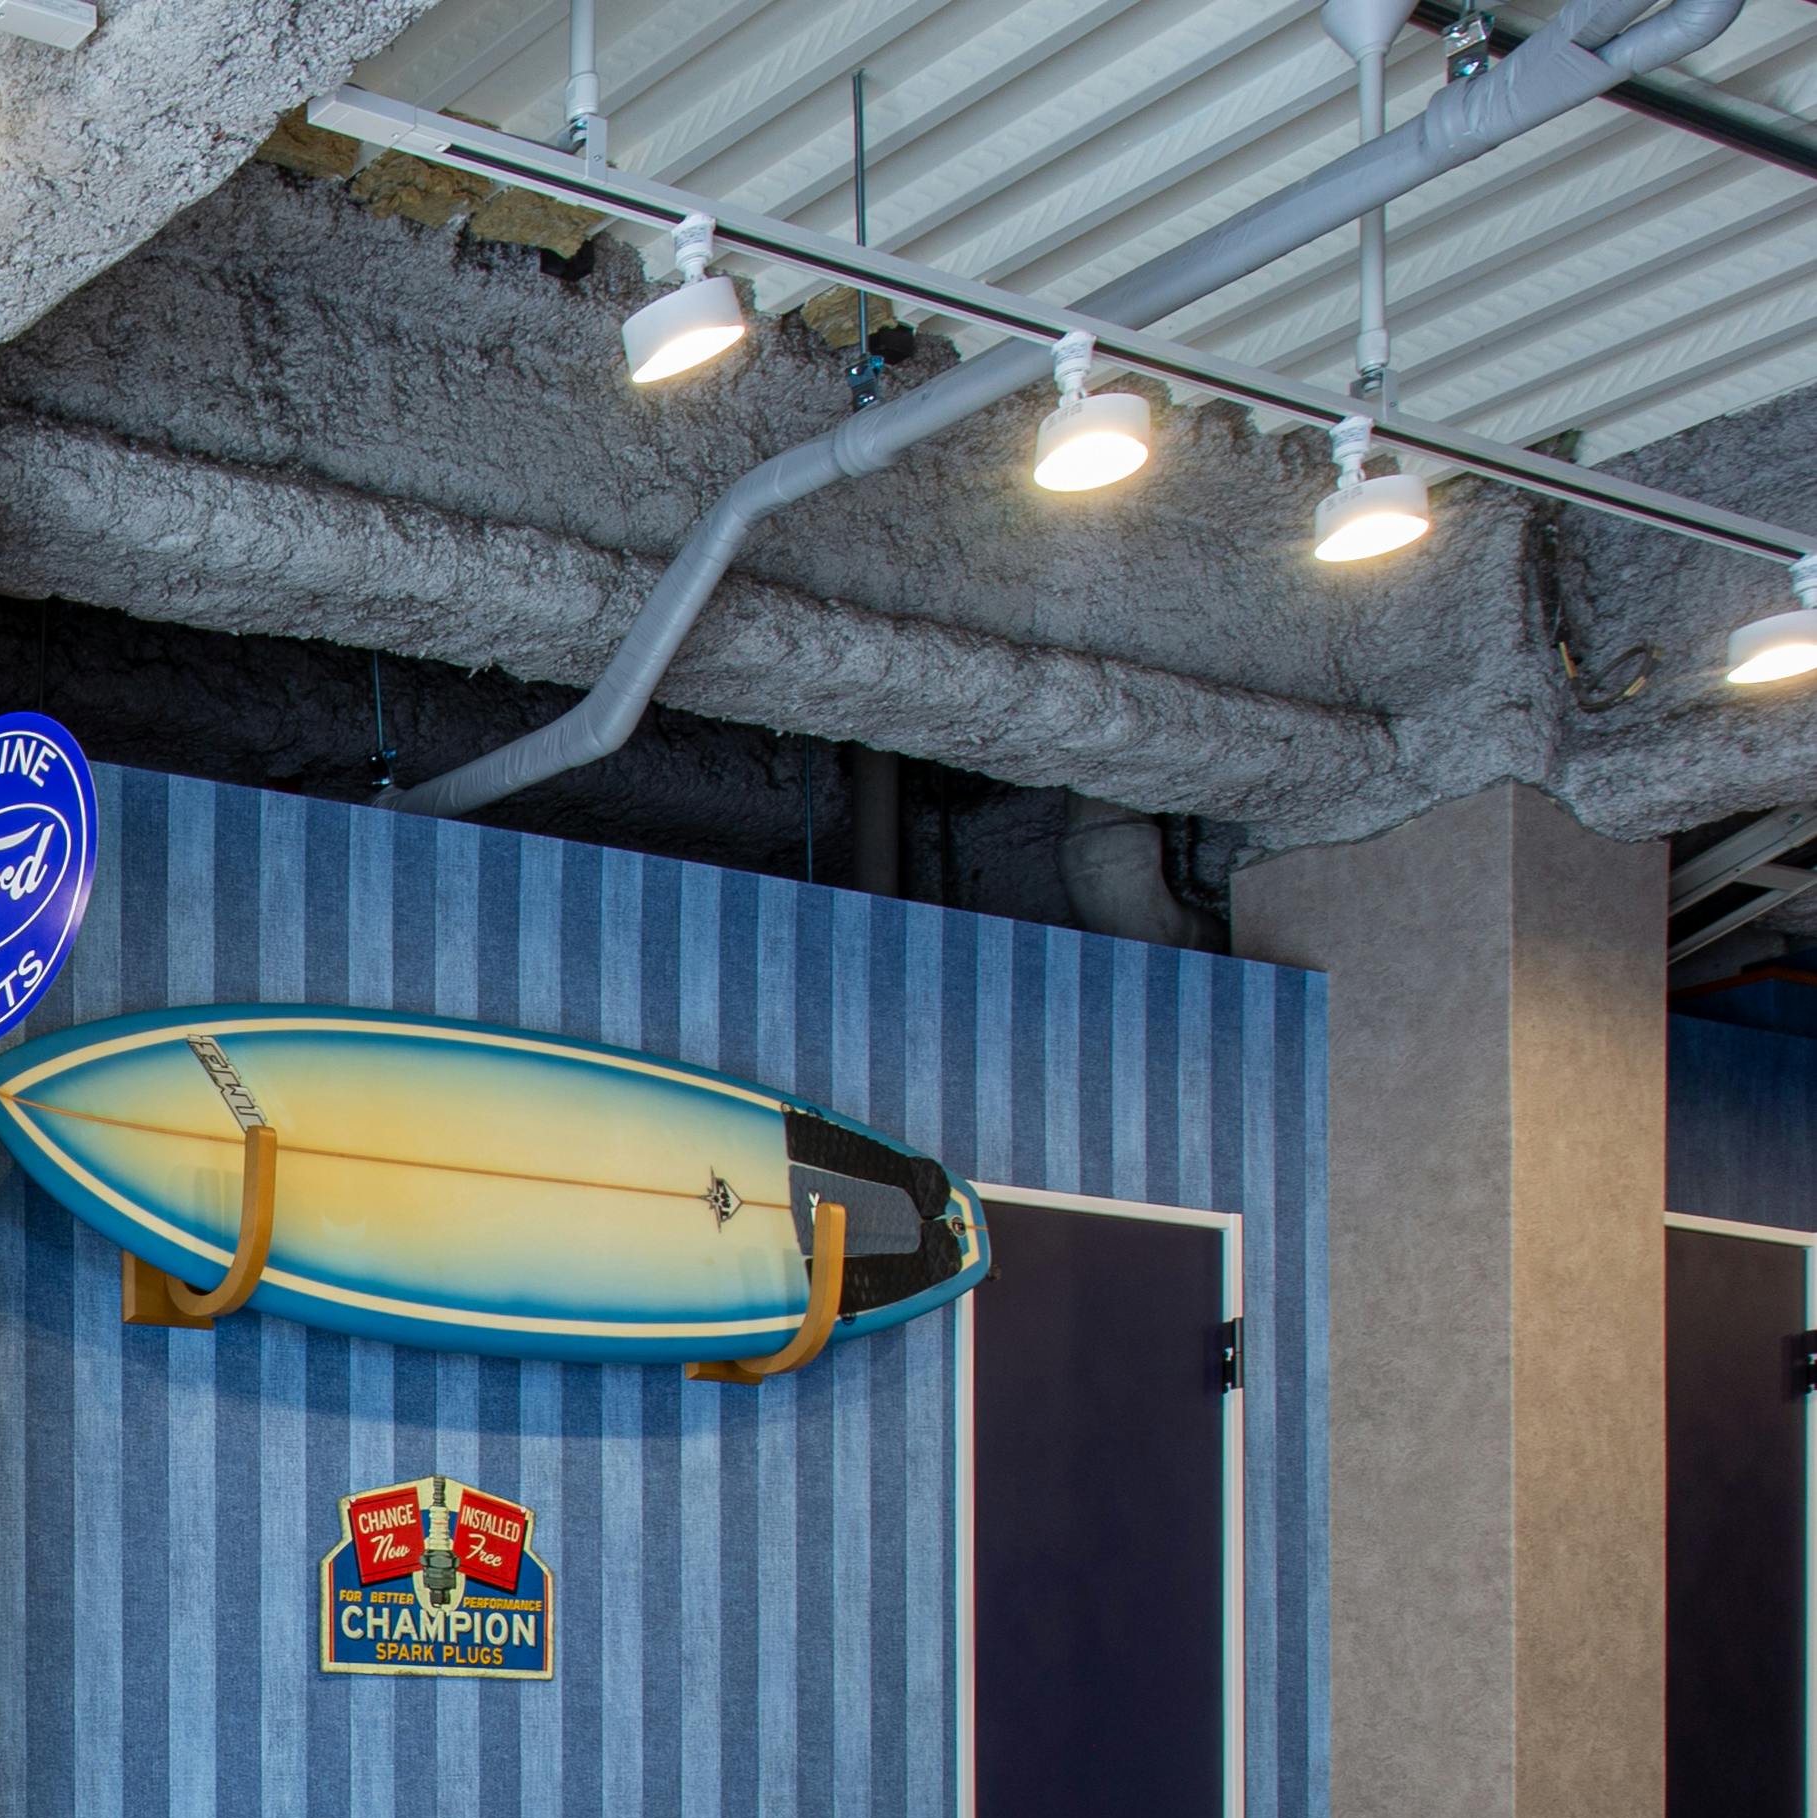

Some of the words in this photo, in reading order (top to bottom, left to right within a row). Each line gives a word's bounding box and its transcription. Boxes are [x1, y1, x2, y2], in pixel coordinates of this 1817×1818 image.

[358, 1503, 416, 1534] CHANGE
[460, 1505, 521, 1543] INSTALLED
[370, 1534, 411, 1563] Now
[465, 1533, 503, 1567] Free
[339, 1589, 363, 1602] FOR
[370, 1590, 415, 1605] BETTER
[462, 1596, 543, 1612] PERFORMANCE
[341, 1605, 537, 1648] CHAMPION
[376, 1643, 435, 1663] SPARK
[442, 1645, 504, 1666] PLUGS
